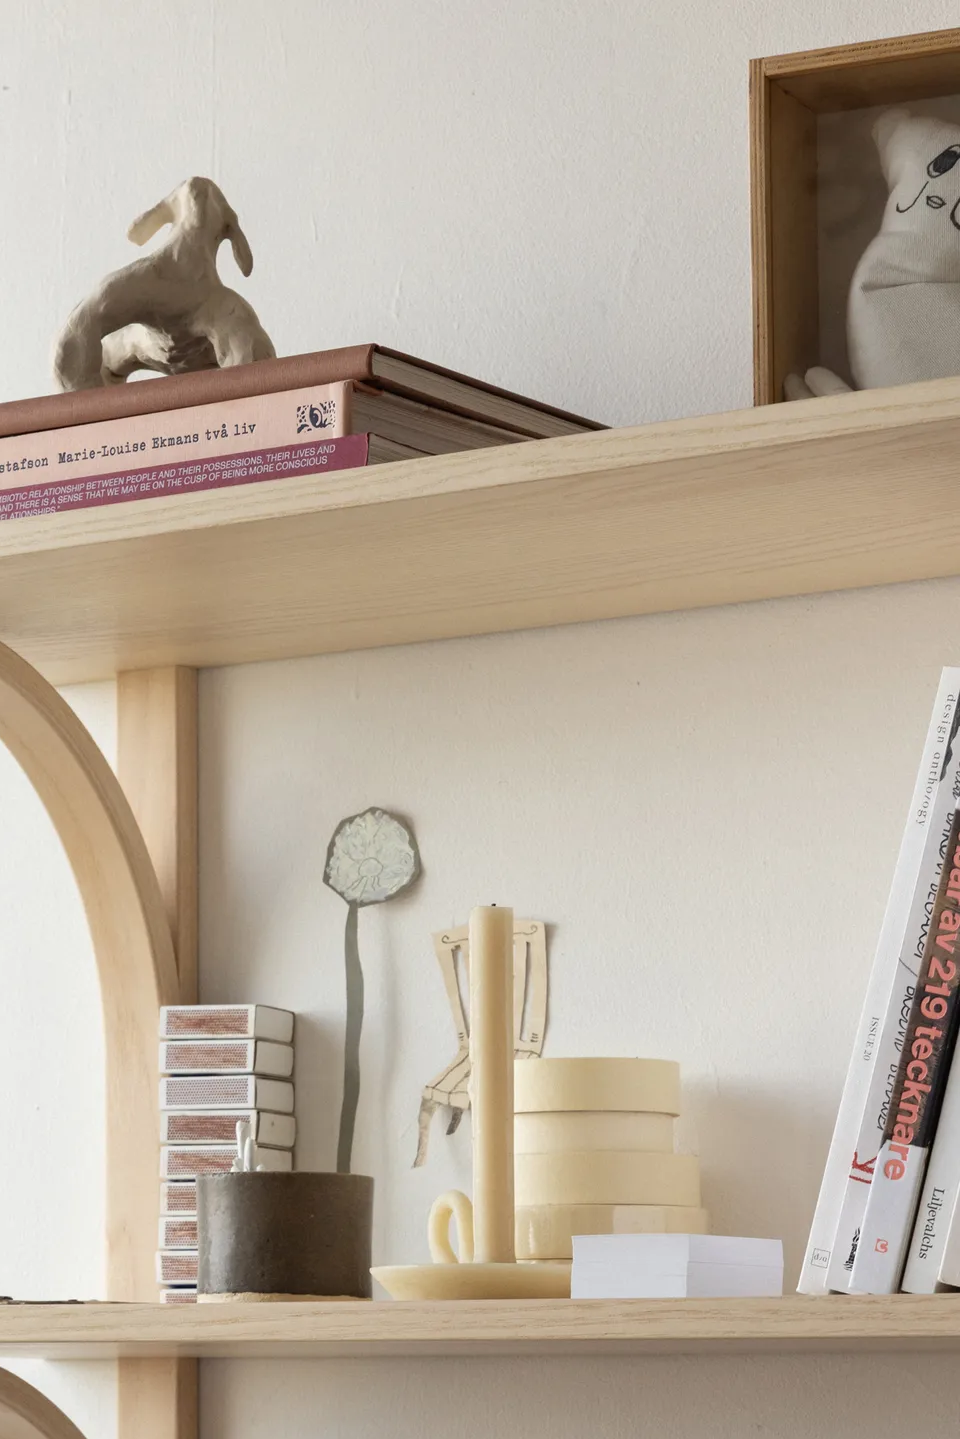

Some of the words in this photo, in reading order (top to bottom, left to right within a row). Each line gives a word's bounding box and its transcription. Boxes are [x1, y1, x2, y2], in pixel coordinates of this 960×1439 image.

[58, 441, 146, 464] Marie-Louise
[151, 433, 199, 450] Ekmans
[204, 423, 229, 441] två
[233, 422, 257, 437] liv
[15, 498, 41, 510] THERE
[40, 497, 50, 507] IS
[50, 496, 57, 505] A
[57, 492, 84, 504] SENSE
[85, 488, 106, 500] THAT
[107, 486, 120, 497] WE
[120, 484, 138, 495] MAY
[139, 482, 151, 492] BE
[152, 480, 165, 490] ON
[166, 477, 183, 488] THE
[183, 473, 208, 485] CUSP
[208, 471, 221, 482] OF
[221, 467, 248, 480] BEING
[248, 463, 275, 475] MORE
[275, 455, 328, 472] CONSCIOUS
[28, 482, 85, 500] RELATIONSHIP
[85, 476, 125, 491] BETWEEN
[125, 471, 157, 484] PEOPLE
[154, 468, 176, 480] AND
[177, 464, 202, 476] THEIR
[202, 455, 264, 473] POSSESSIONS,
[266, 451, 291, 463] THEIR
[291, 447, 316, 459] LIVES
[316, 444, 336, 455] AND
[936, 694, 957, 743] design
[936, 910, 960, 952] av
[921, 958, 956, 1019] 219
[863, 1049, 872, 1062] 20
[866, 1016, 880, 1048] ISSUE
[885, 1027, 941, 1180] tecknare
[918, 1187, 945, 1259] Liljevalchs
